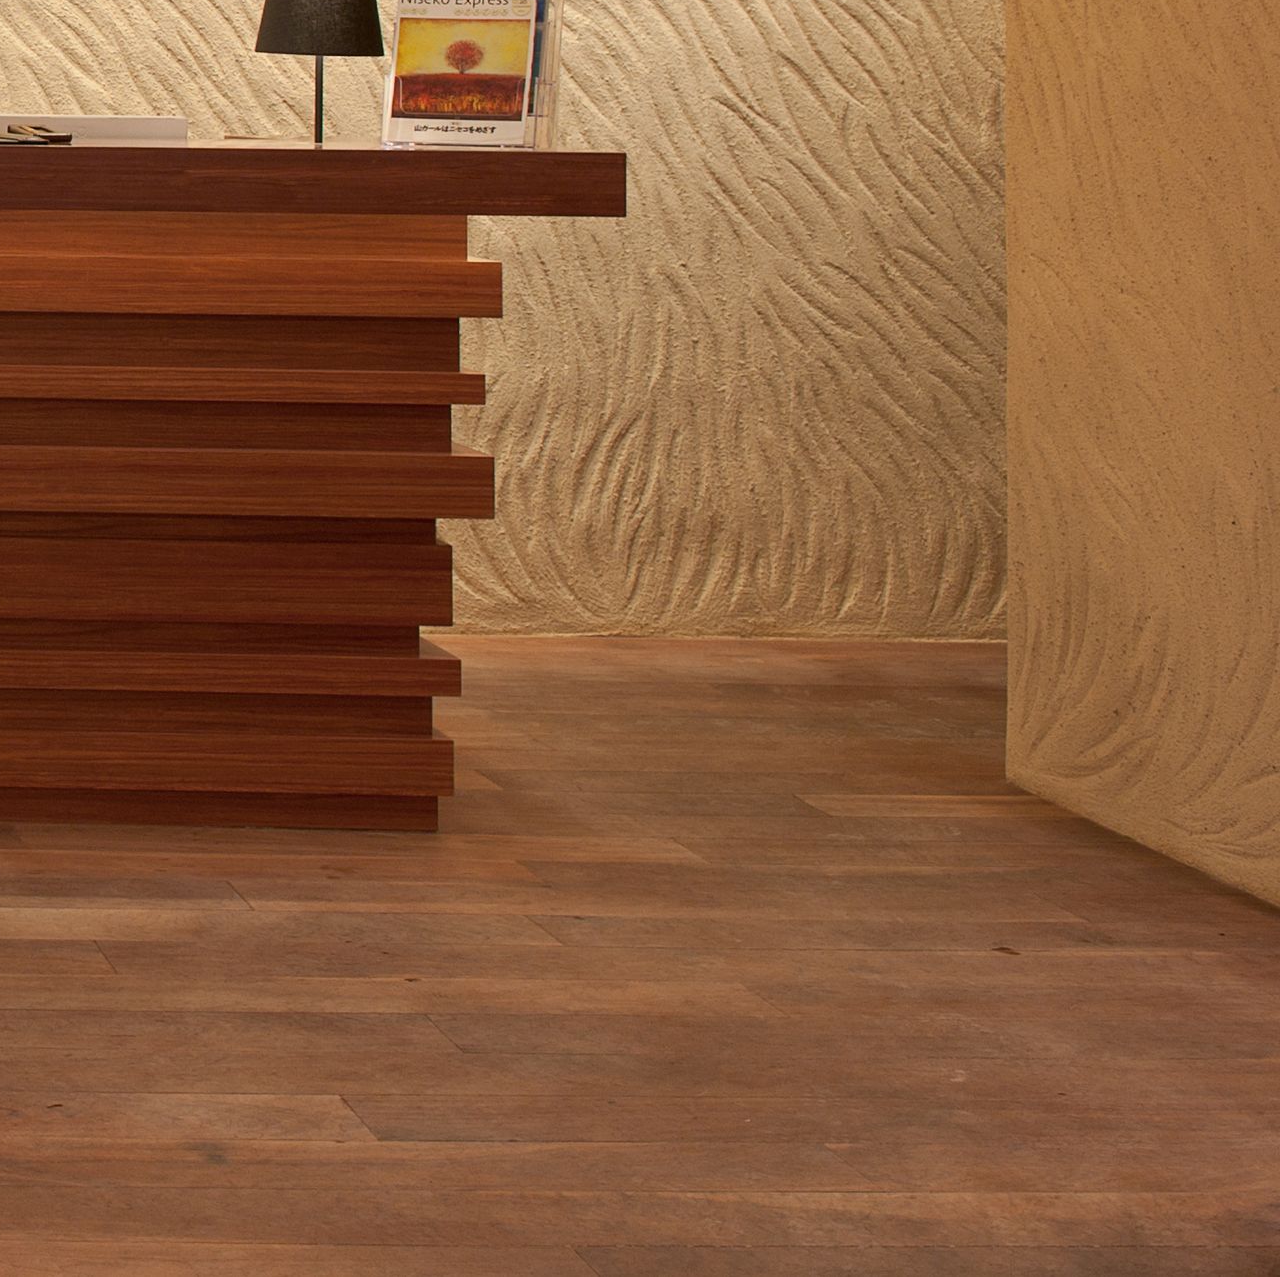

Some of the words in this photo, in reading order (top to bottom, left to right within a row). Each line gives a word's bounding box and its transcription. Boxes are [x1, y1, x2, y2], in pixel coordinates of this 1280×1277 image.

[414, 124, 497, 134] 山ガールはニセコをめざす
